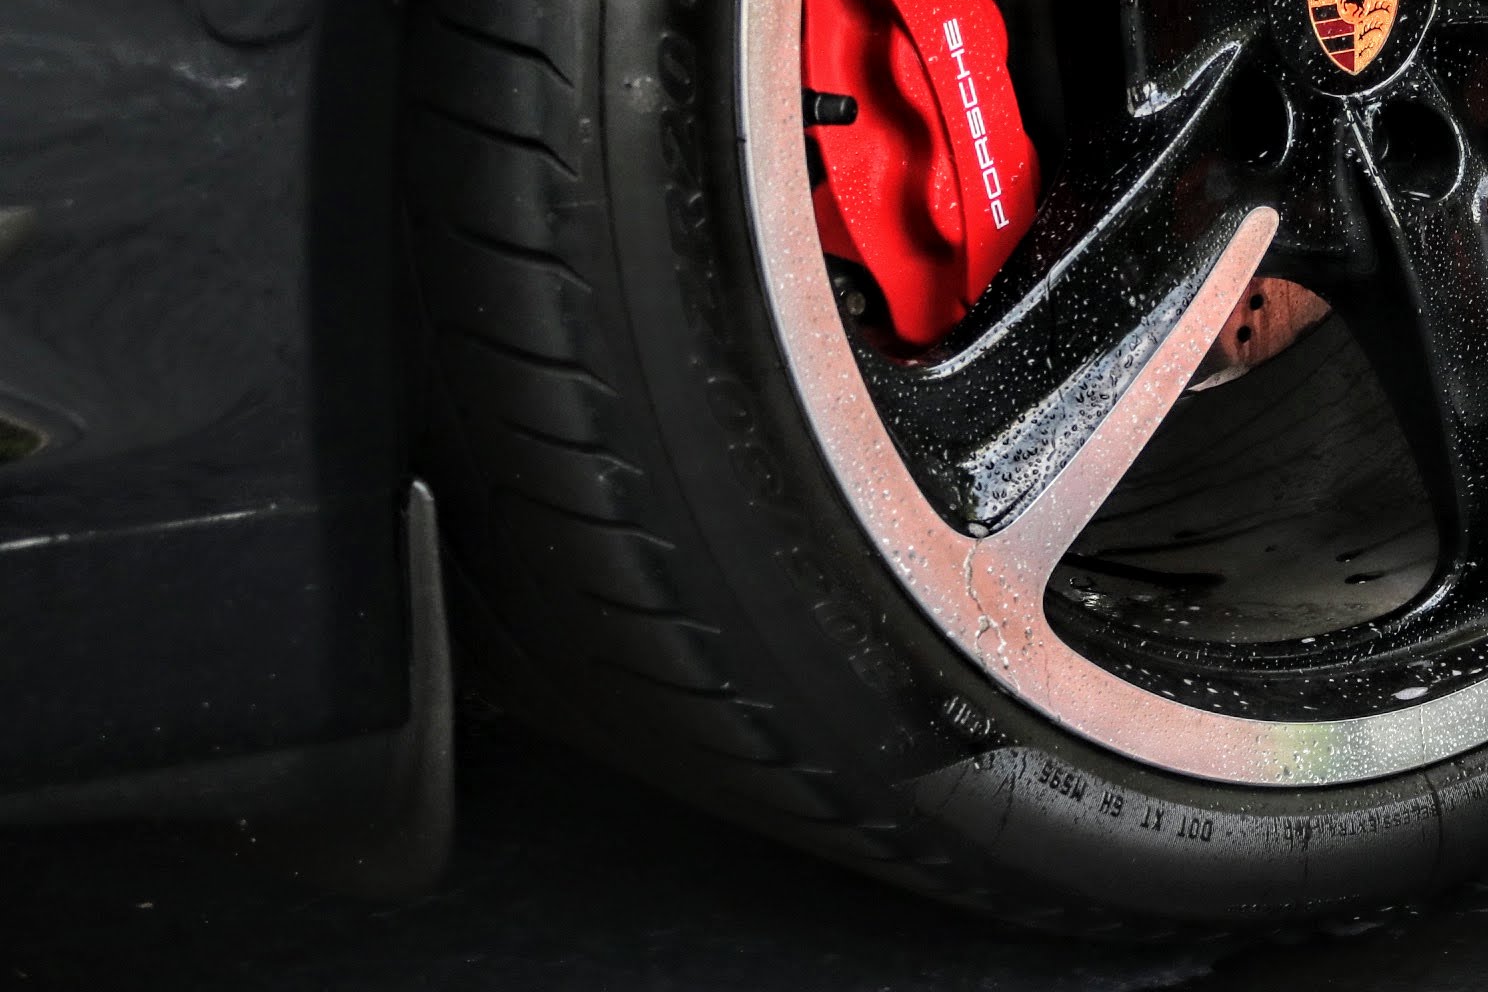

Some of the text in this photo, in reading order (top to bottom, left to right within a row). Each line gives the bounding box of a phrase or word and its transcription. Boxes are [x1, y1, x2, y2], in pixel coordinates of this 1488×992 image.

[943, 18, 1009, 230] PORSCHE
[1140, 806, 1166, 832] XT
[1177, 817, 1213, 842] DOT
